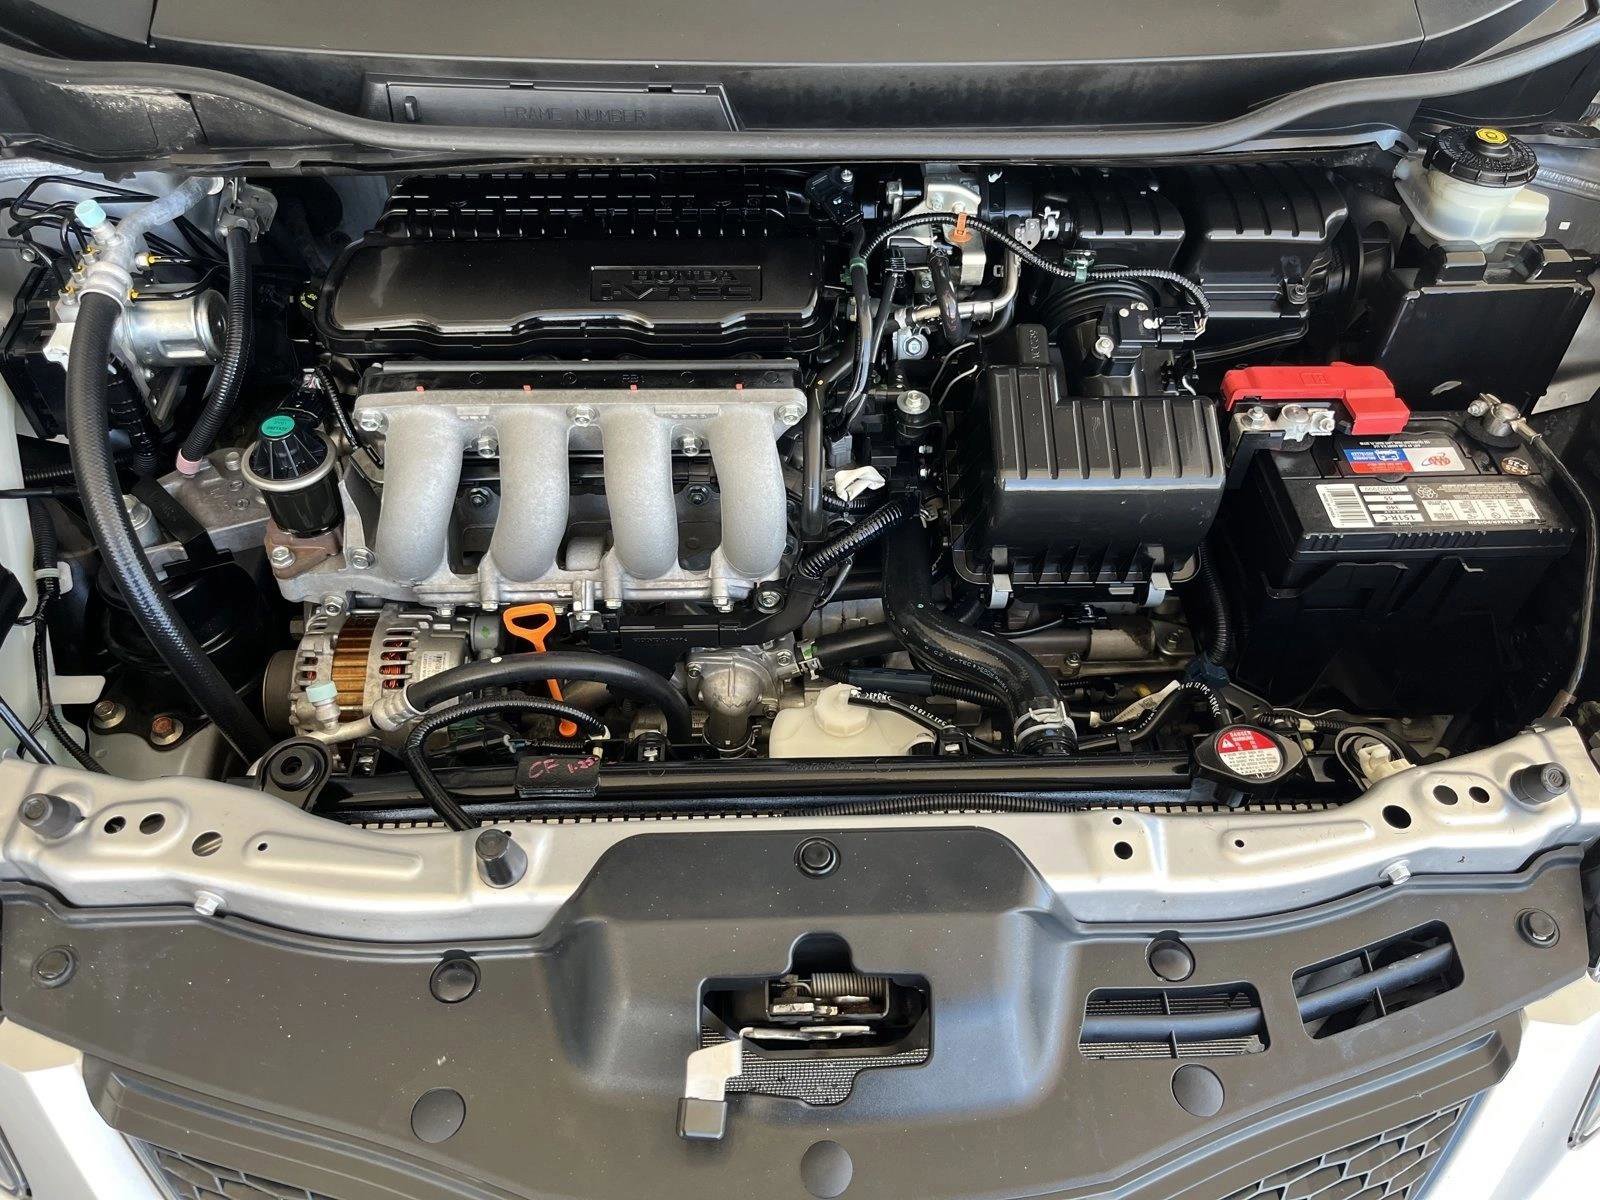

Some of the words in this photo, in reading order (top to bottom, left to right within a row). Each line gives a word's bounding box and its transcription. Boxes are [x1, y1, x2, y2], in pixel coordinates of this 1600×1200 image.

[503, 106, 562, 121] FRAME
[575, 108, 647, 123] NUMBER
[631, 270, 740, 285] HONDA
